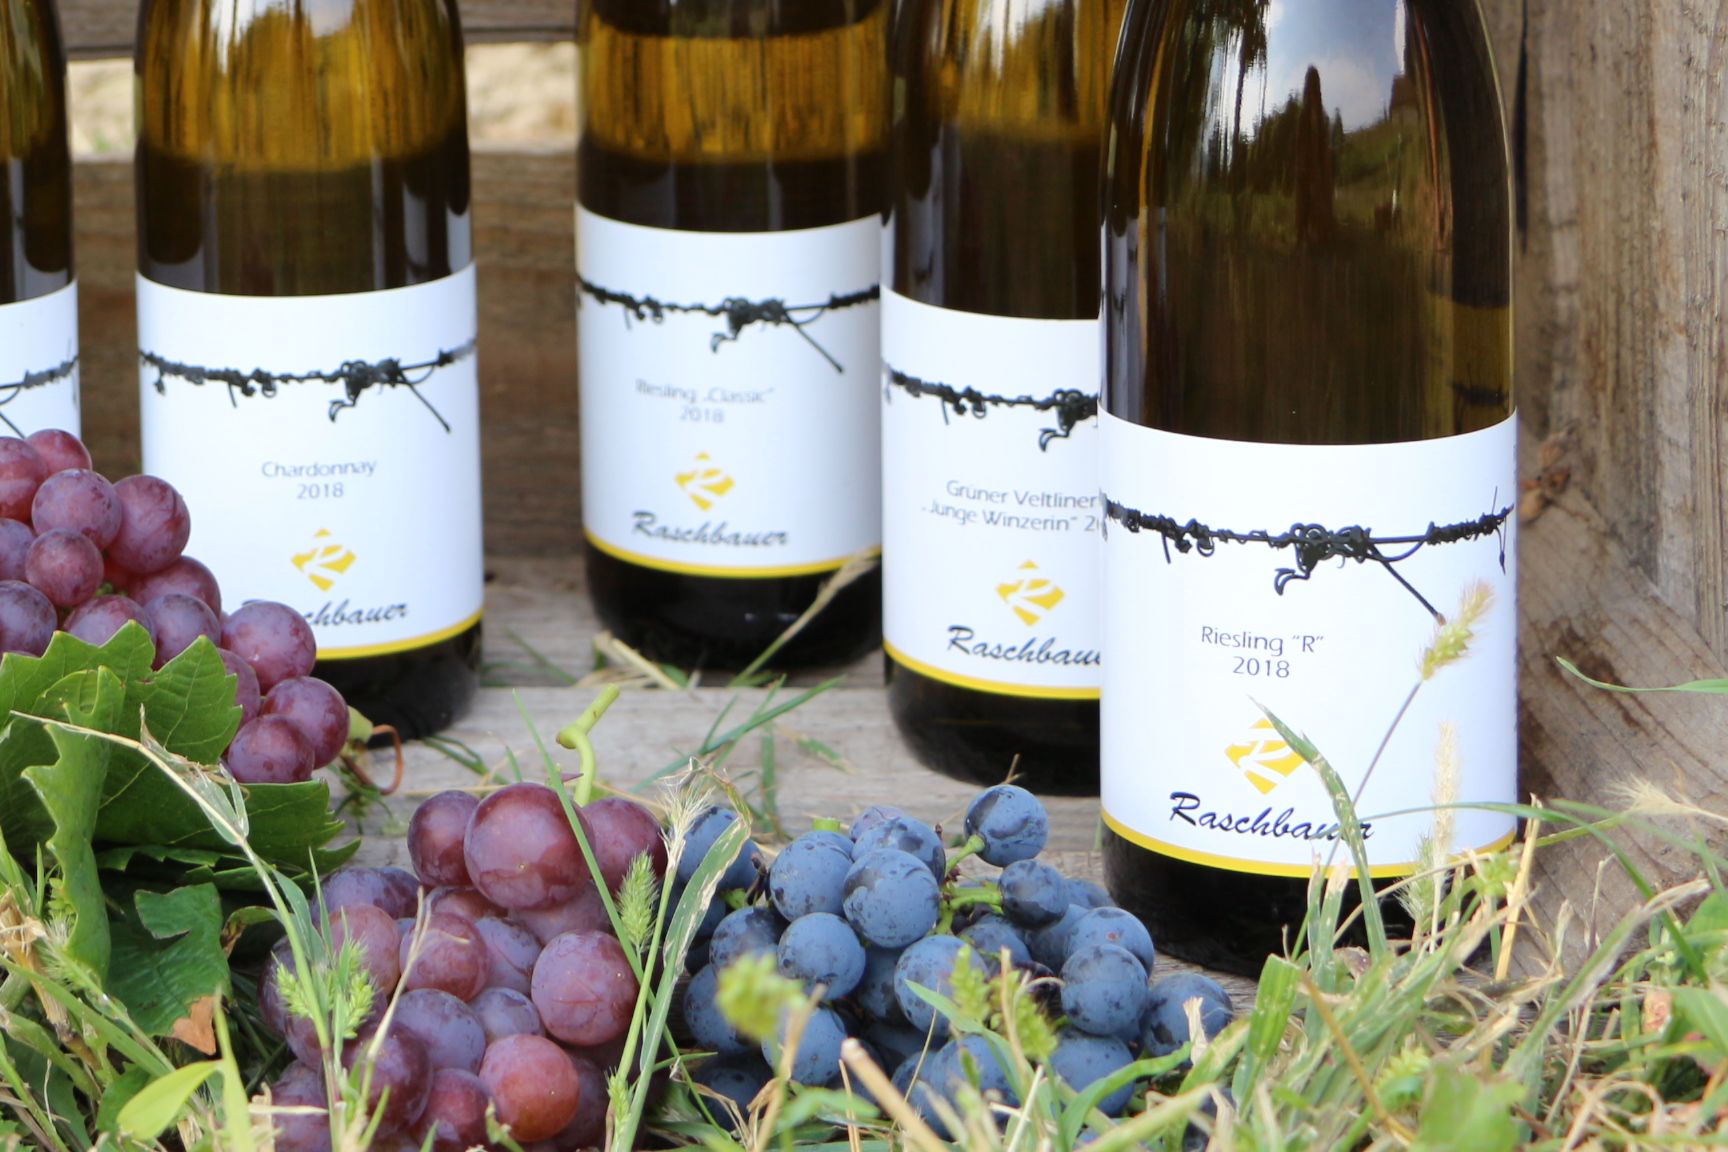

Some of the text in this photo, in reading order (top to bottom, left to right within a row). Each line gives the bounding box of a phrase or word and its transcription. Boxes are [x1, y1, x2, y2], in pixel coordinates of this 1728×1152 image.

[635, 377, 696, 404] Riesling
[680, 405, 725, 424] 2018
[261, 459, 377, 478] Chardonnay
[296, 481, 344, 500] 2018
[945, 479, 1096, 509] Grüner Veltliner
[632, 509, 788, 546] Raschbauer
[1201, 625, 1284, 657] Riesling
[1232, 655, 1290, 679] 2018
[1169, 790, 1375, 841] Raschbaur
